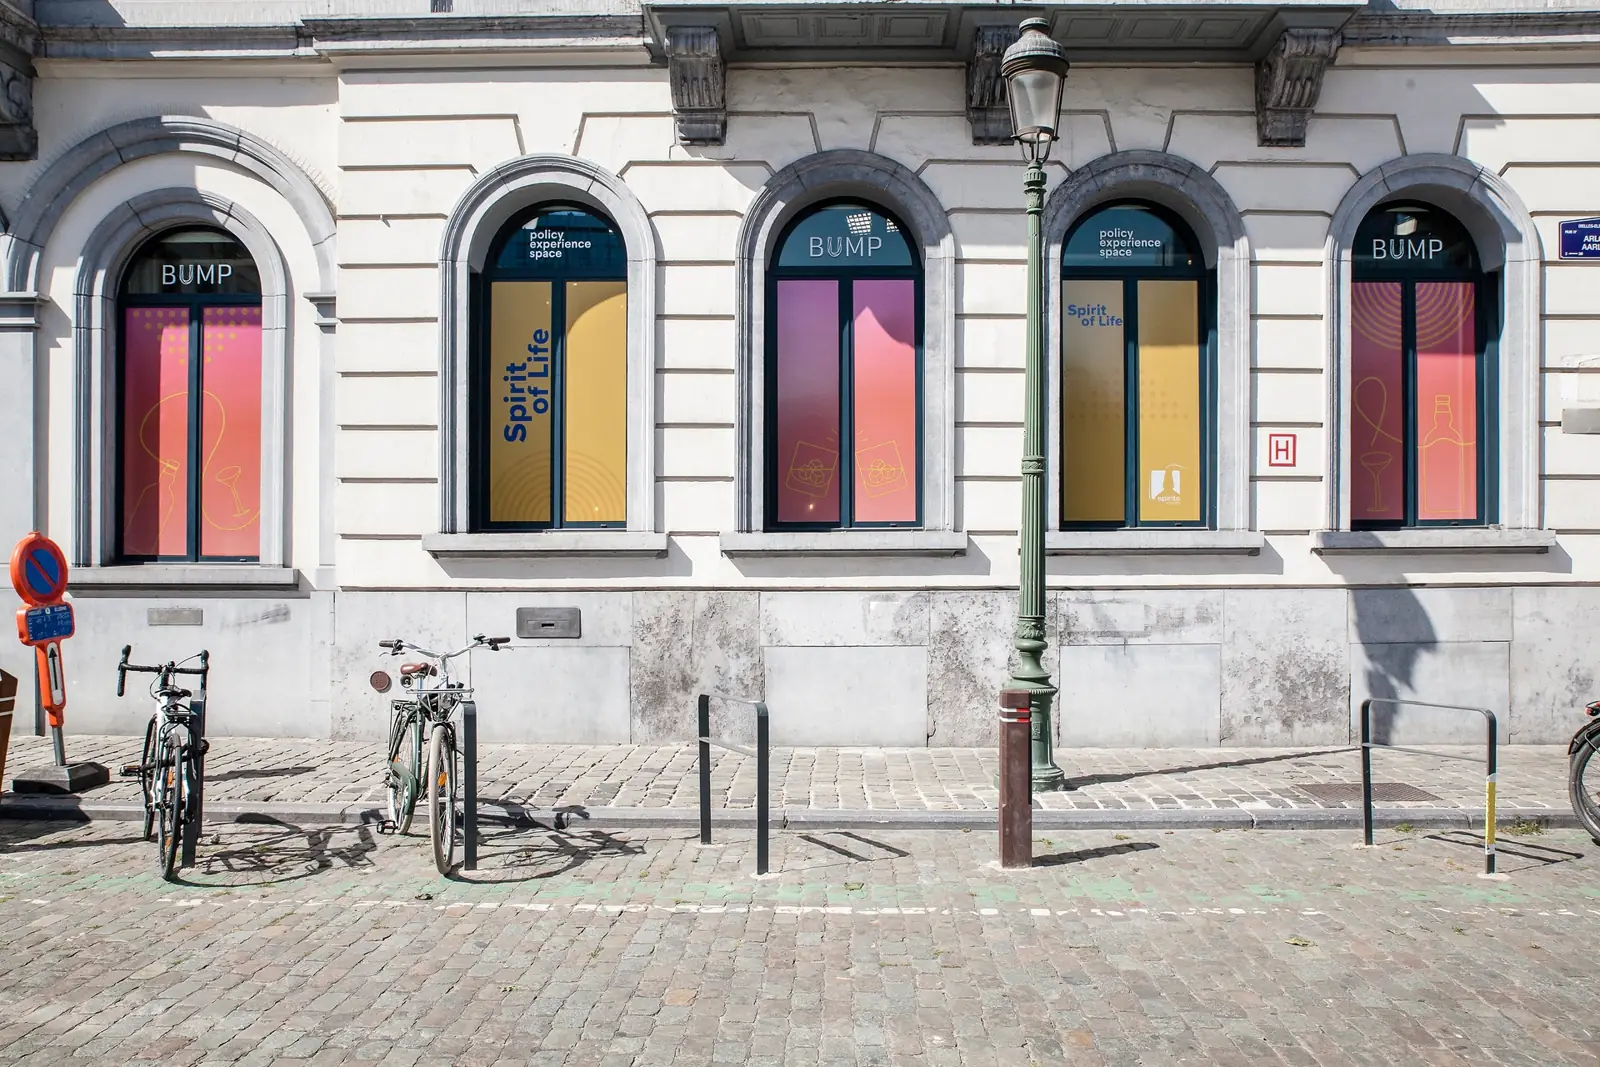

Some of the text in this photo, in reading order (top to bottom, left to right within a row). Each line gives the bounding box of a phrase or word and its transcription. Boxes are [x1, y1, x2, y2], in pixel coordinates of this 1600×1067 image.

[530, 229, 564, 241] policy
[1099, 228, 1133, 240] policy
[530, 239, 591, 250] experience
[809, 236, 882, 257] BUMP
[1099, 238, 1161, 249] experience
[1373, 239, 1443, 259] BUMP
[530, 250, 562, 260] space
[1099, 249, 1132, 259] space
[162, 264, 232, 285] BUMP
[1067, 304, 1107, 318] Spirit
[1081, 316, 1123, 326] of Life
[527, 329, 549, 414] of Life
[503, 362, 532, 442] Spirit
[1275, 440, 1289, 460] H
